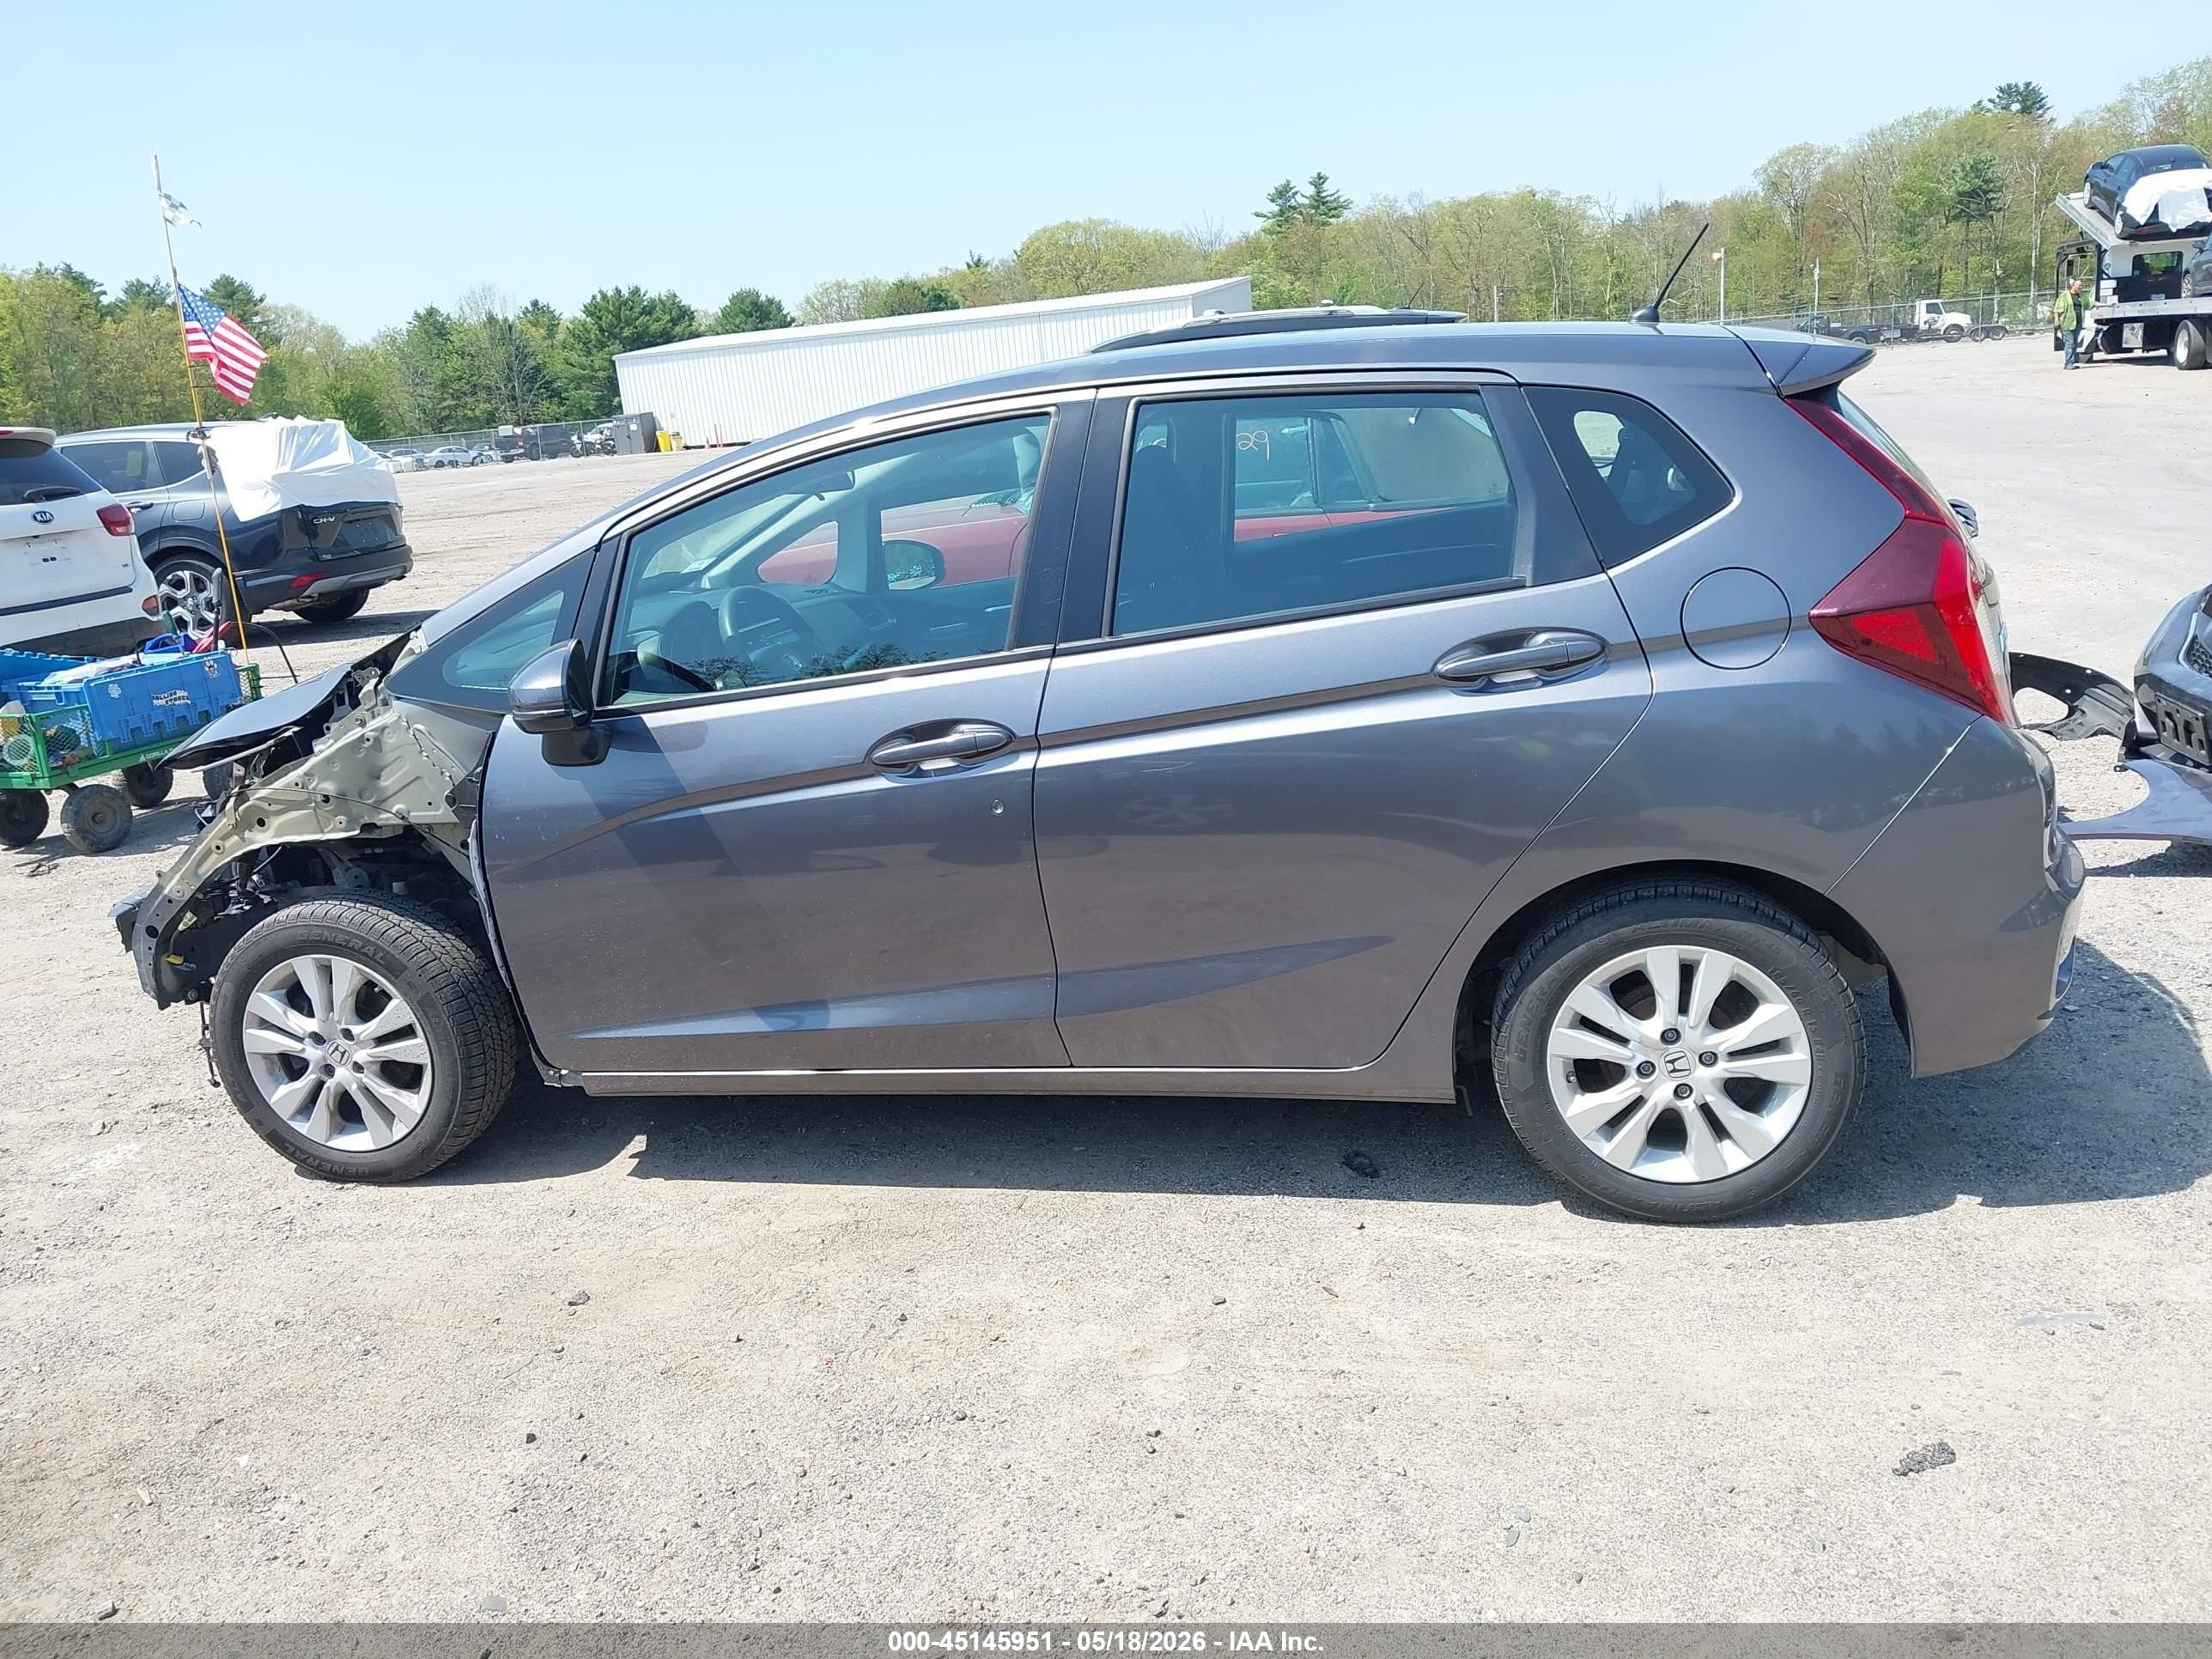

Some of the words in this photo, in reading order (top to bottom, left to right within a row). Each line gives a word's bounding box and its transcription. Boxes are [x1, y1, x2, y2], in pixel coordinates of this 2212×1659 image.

[34, 512, 53, 522] KIA
[299, 930, 386, 964] GENERAL
[283, 1143, 372, 1175] GENERAL
